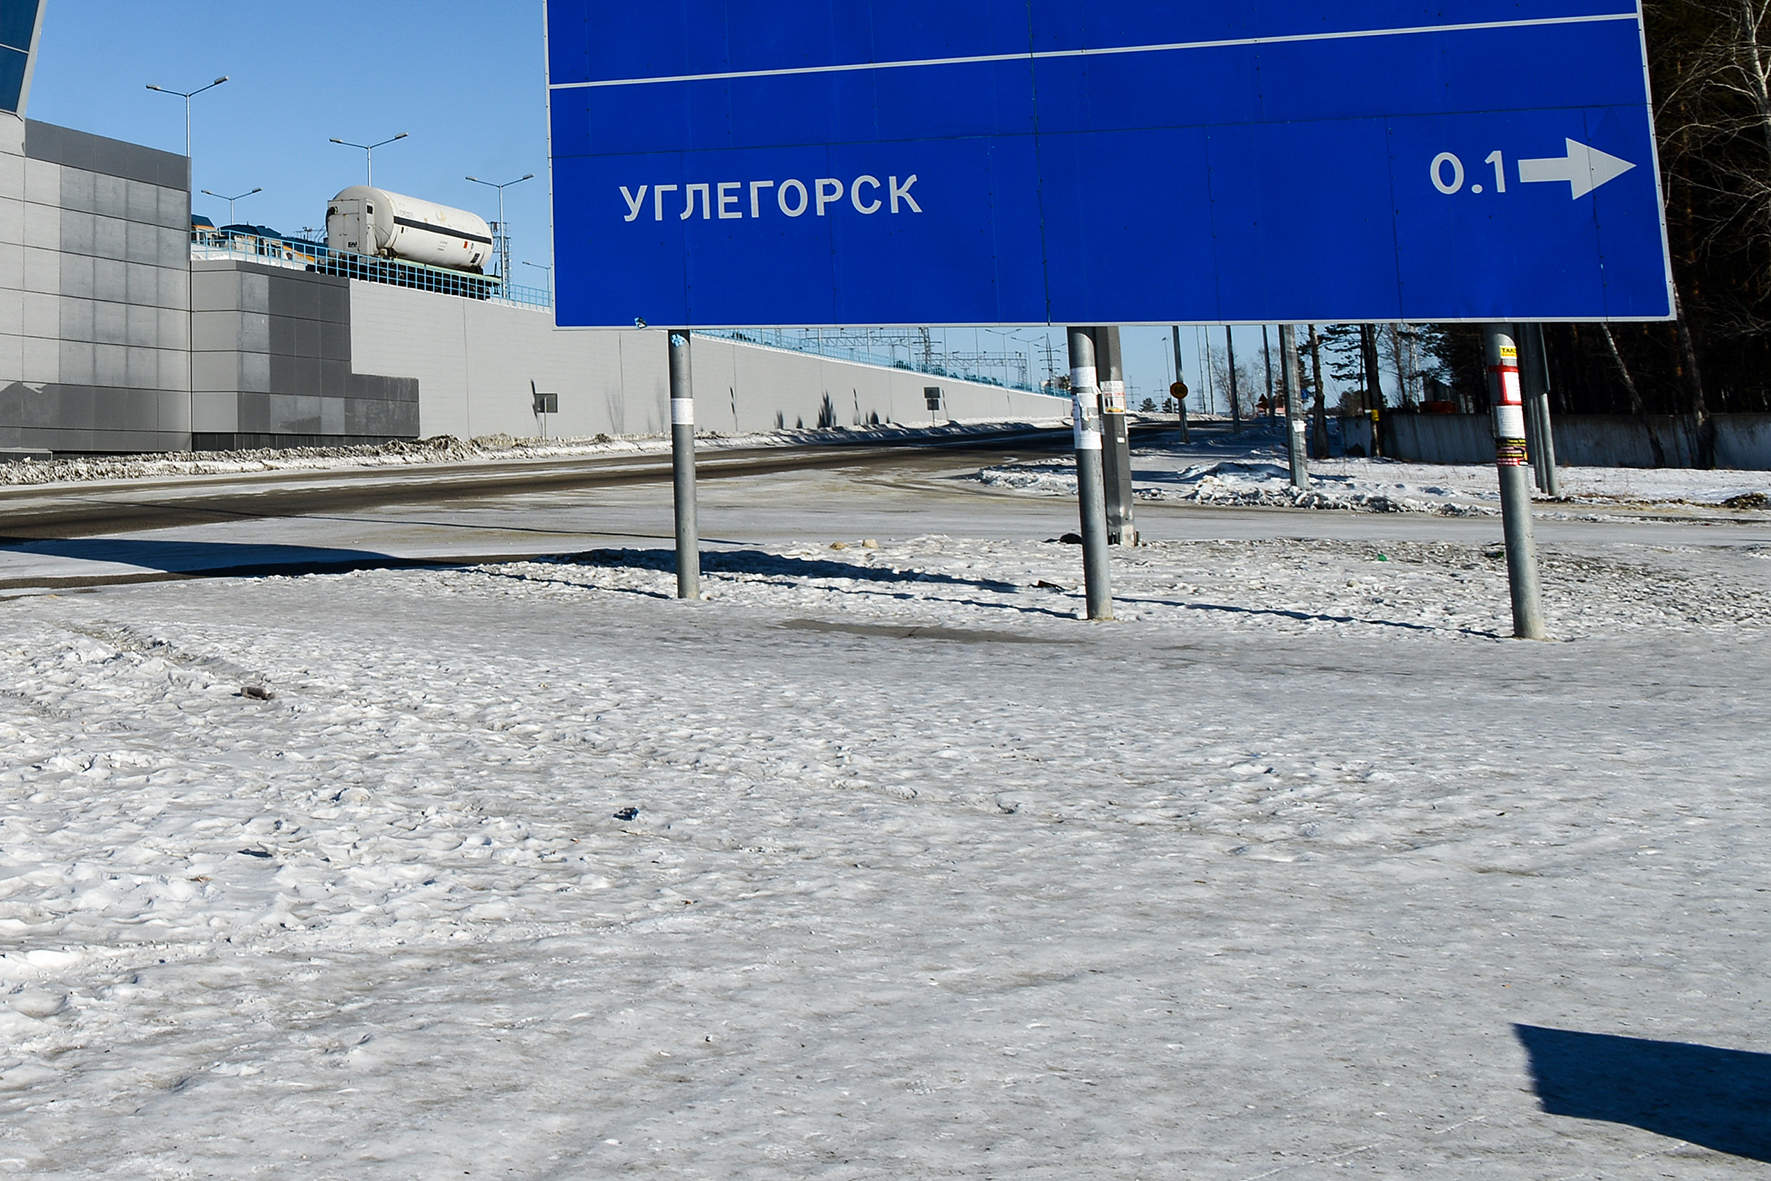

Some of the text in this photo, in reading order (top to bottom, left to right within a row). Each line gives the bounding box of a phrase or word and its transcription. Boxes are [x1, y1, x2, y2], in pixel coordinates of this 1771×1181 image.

[1430, 150, 1506, 195] 0.1
[619, 174, 923, 222] УГЛЕГОРСК
[1173, 385, 1186, 395] 60
